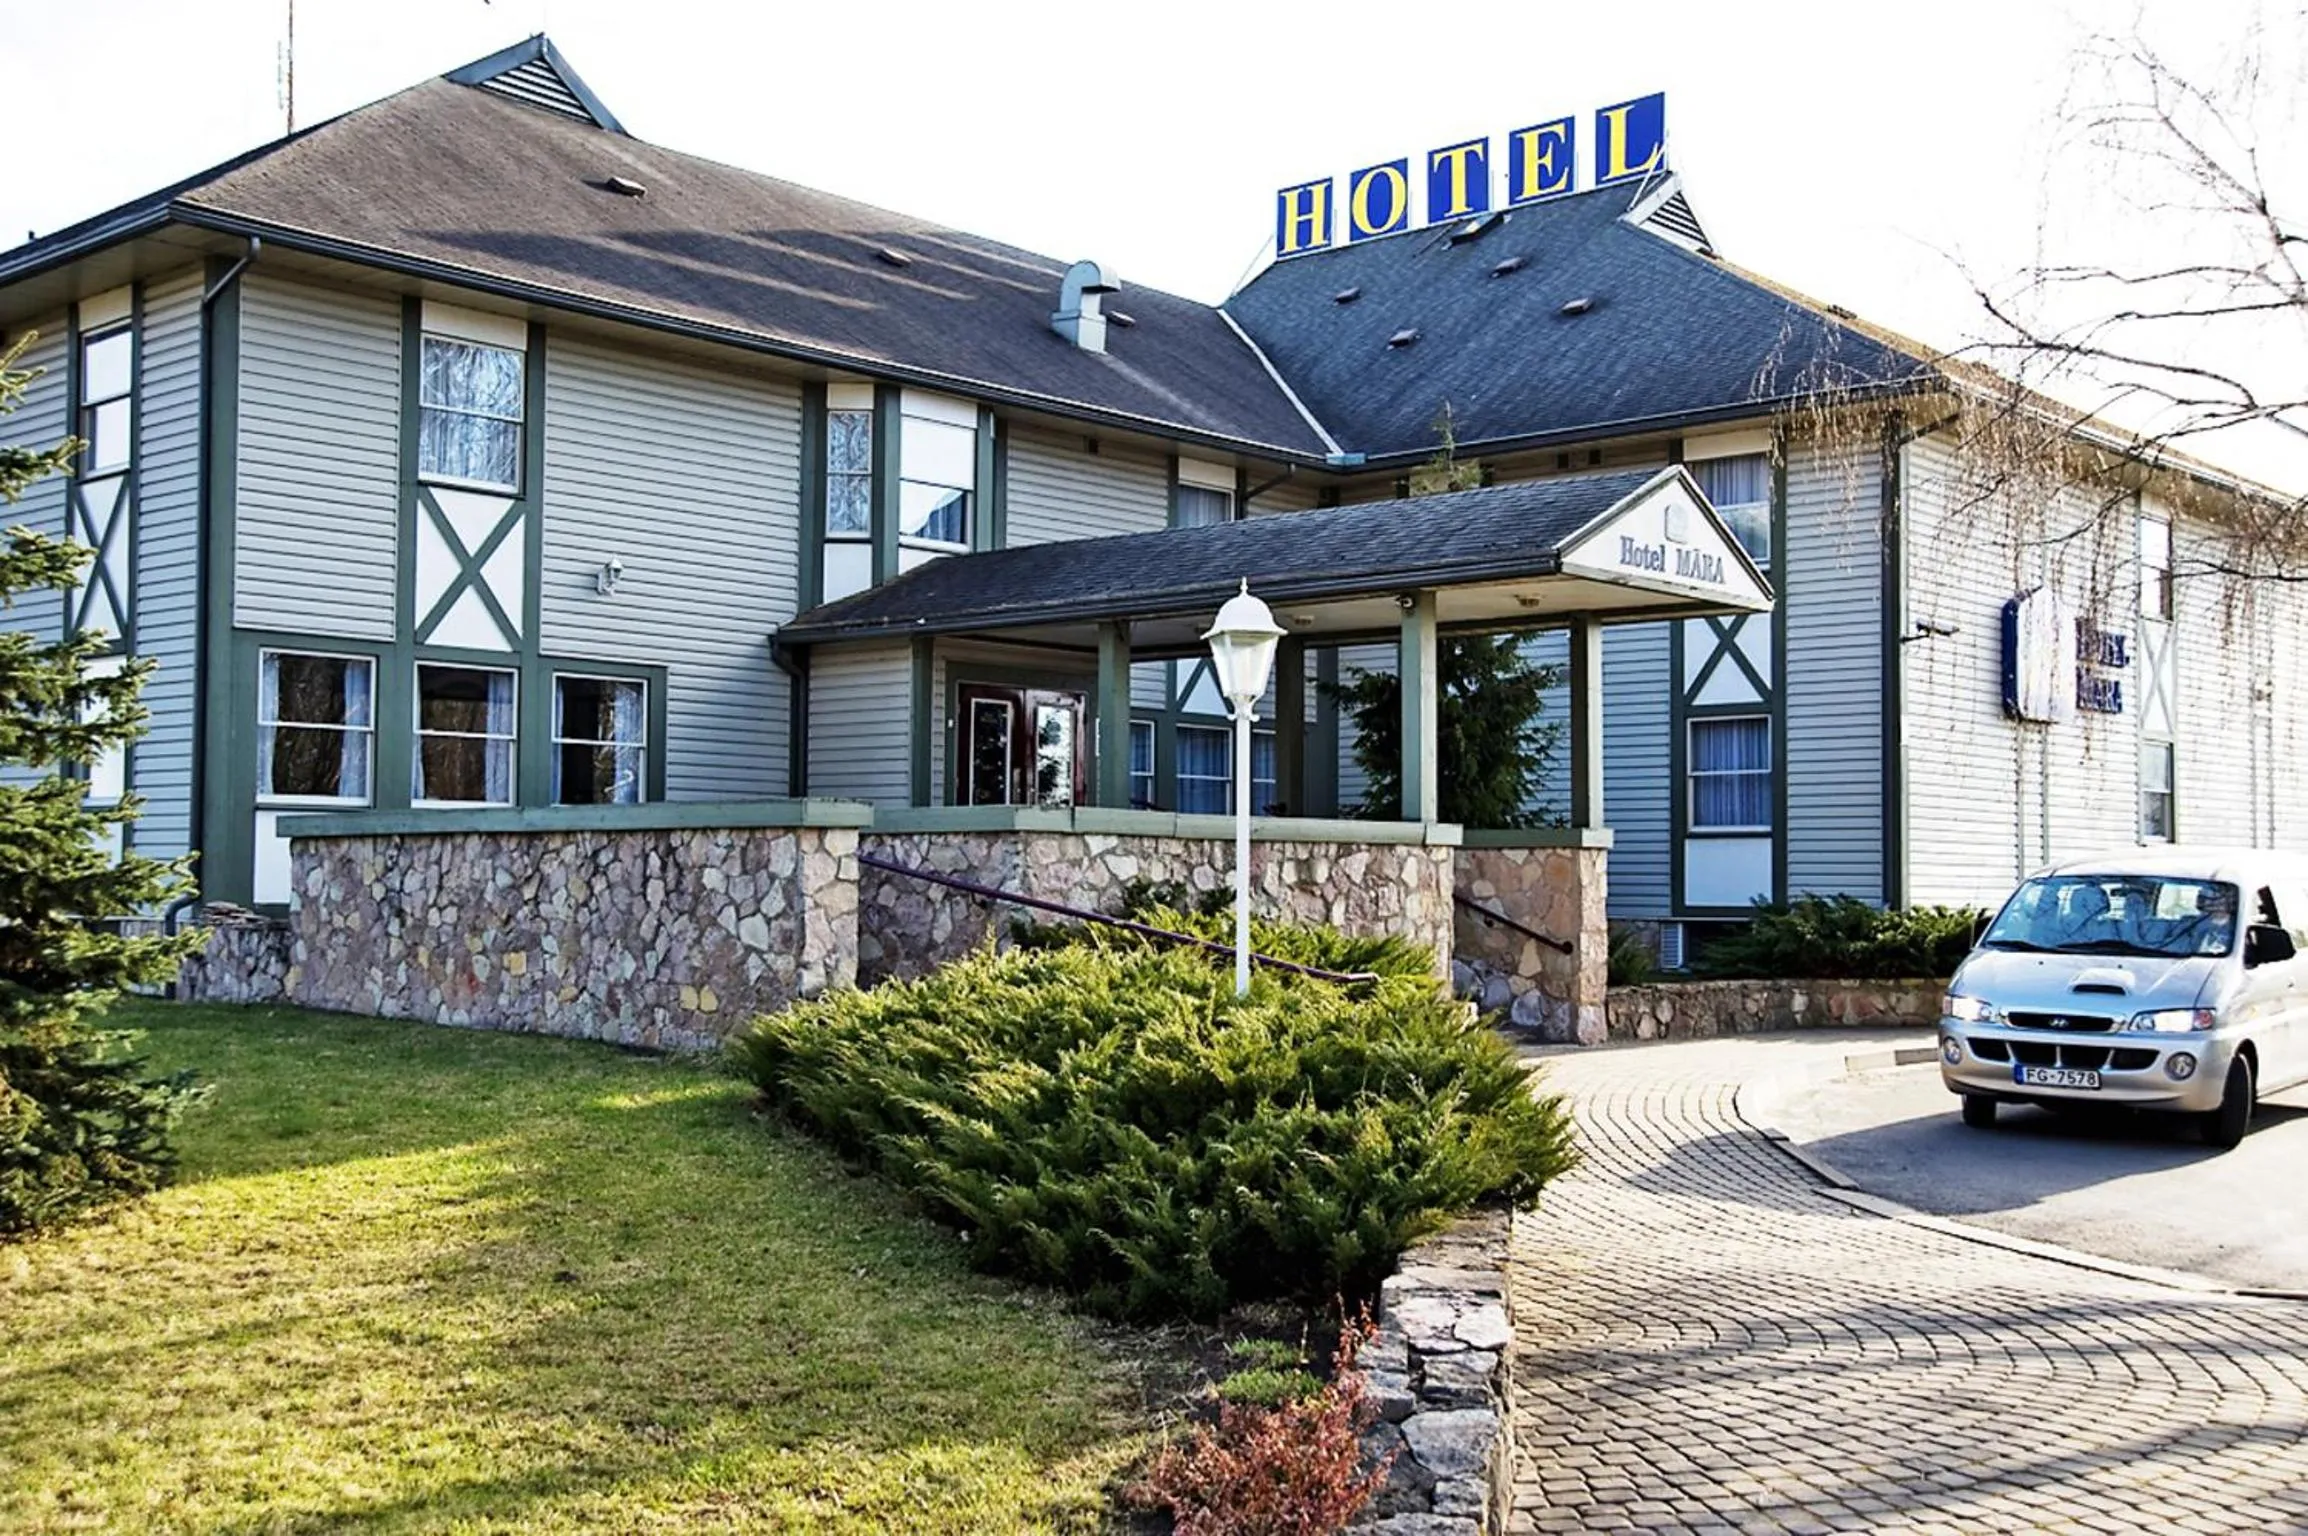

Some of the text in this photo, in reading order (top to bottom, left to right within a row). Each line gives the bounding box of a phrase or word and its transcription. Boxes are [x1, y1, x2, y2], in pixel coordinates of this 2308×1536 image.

[1279, 105, 1663, 254] HOTEL
[1620, 536, 1665, 572] Hotel
[2026, 1069, 2096, 1086] FG-7578
